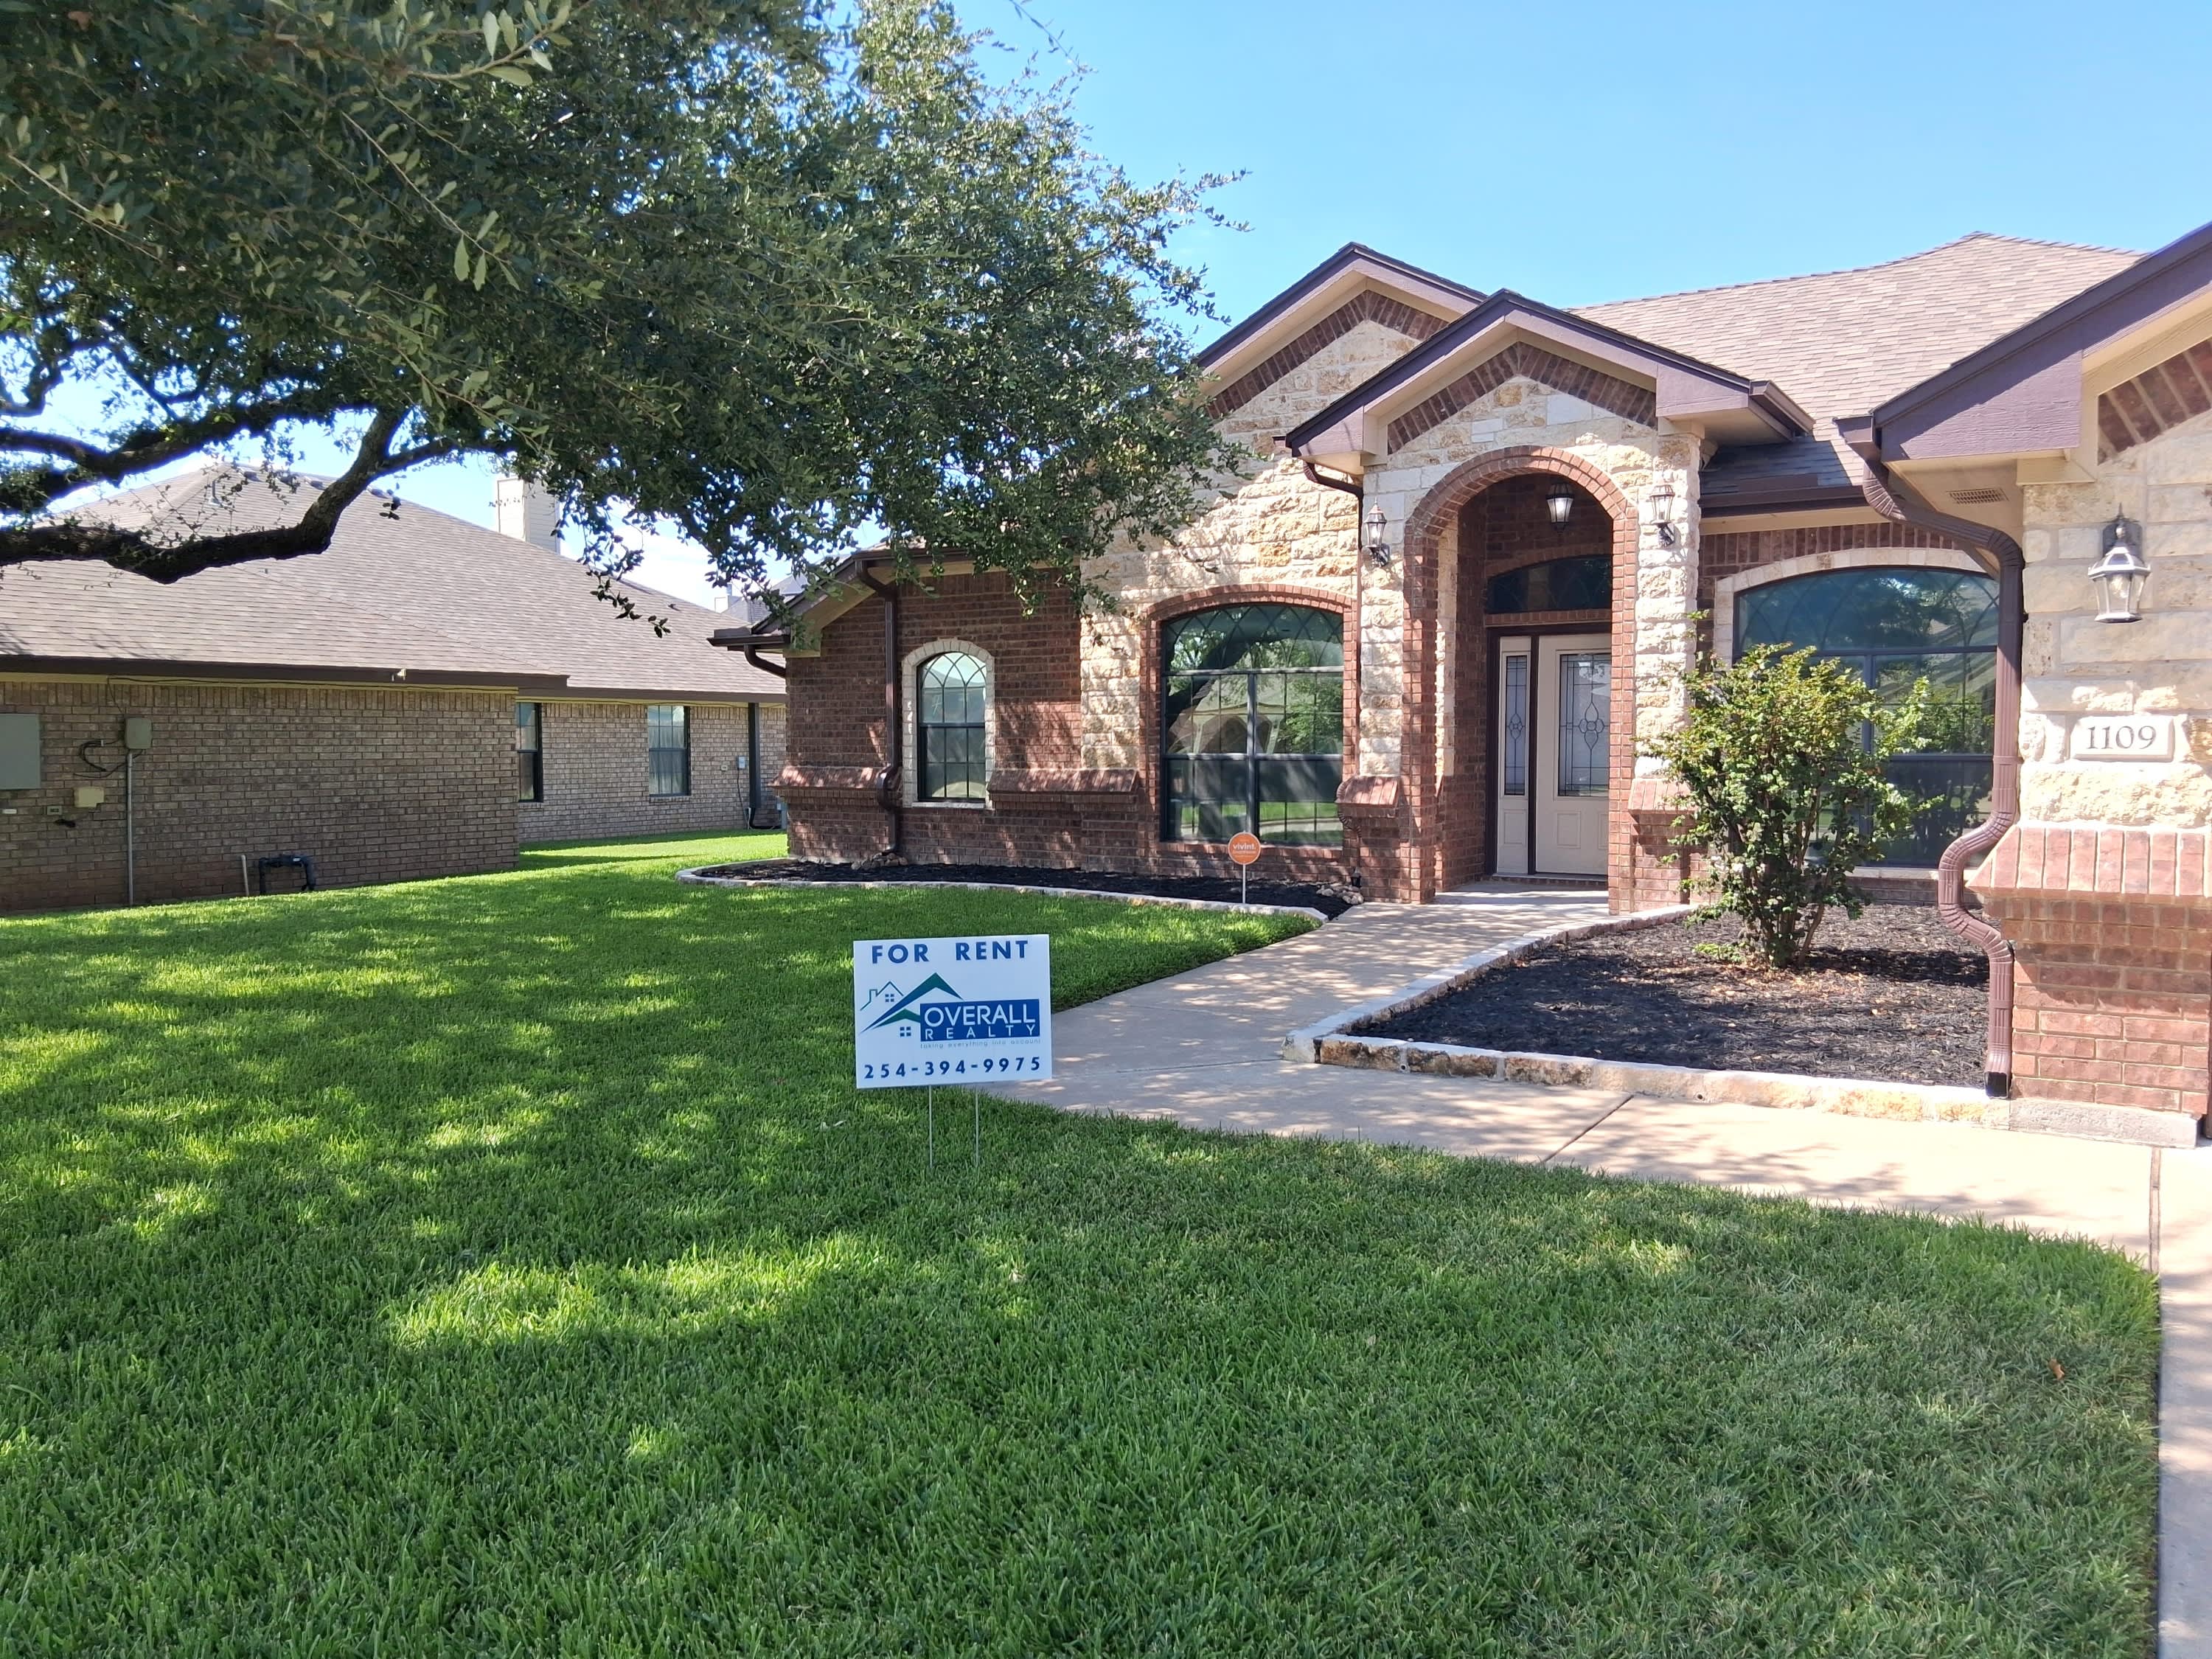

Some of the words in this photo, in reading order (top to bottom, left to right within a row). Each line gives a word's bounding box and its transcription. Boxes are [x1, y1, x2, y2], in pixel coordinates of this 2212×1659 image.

[2086, 726, 2157, 750] 1109
[872, 943, 929, 964] FOR
[956, 940, 1029, 961] RENT
[924, 1003, 1036, 1027] OVERALL
[925, 1025, 1035, 1040] REALTY
[864, 1056, 1040, 1079] 254-394-9975
